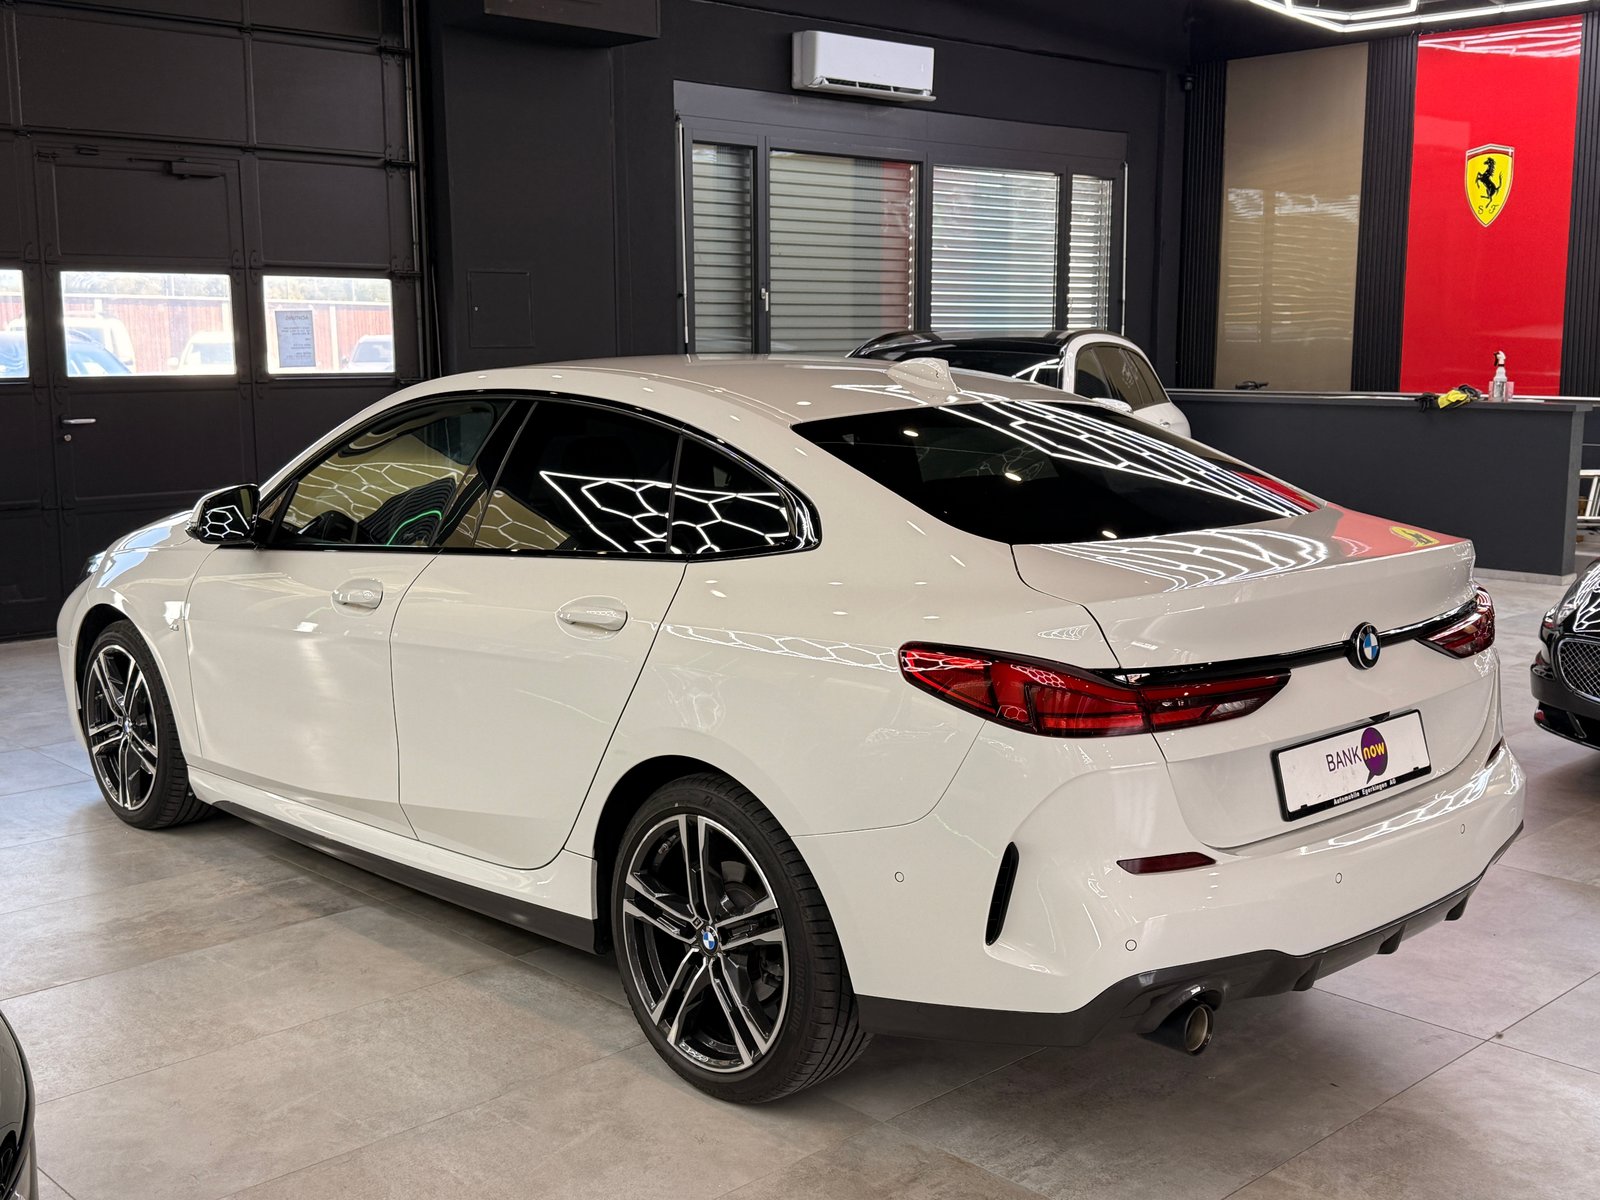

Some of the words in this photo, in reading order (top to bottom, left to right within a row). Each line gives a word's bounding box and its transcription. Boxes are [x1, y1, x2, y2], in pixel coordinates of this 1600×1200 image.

[1326, 745, 1362, 772] BANK
[1363, 742, 1385, 760] now
[1333, 791, 1360, 805] Automobile
[1361, 782, 1388, 796] Egerkingen
